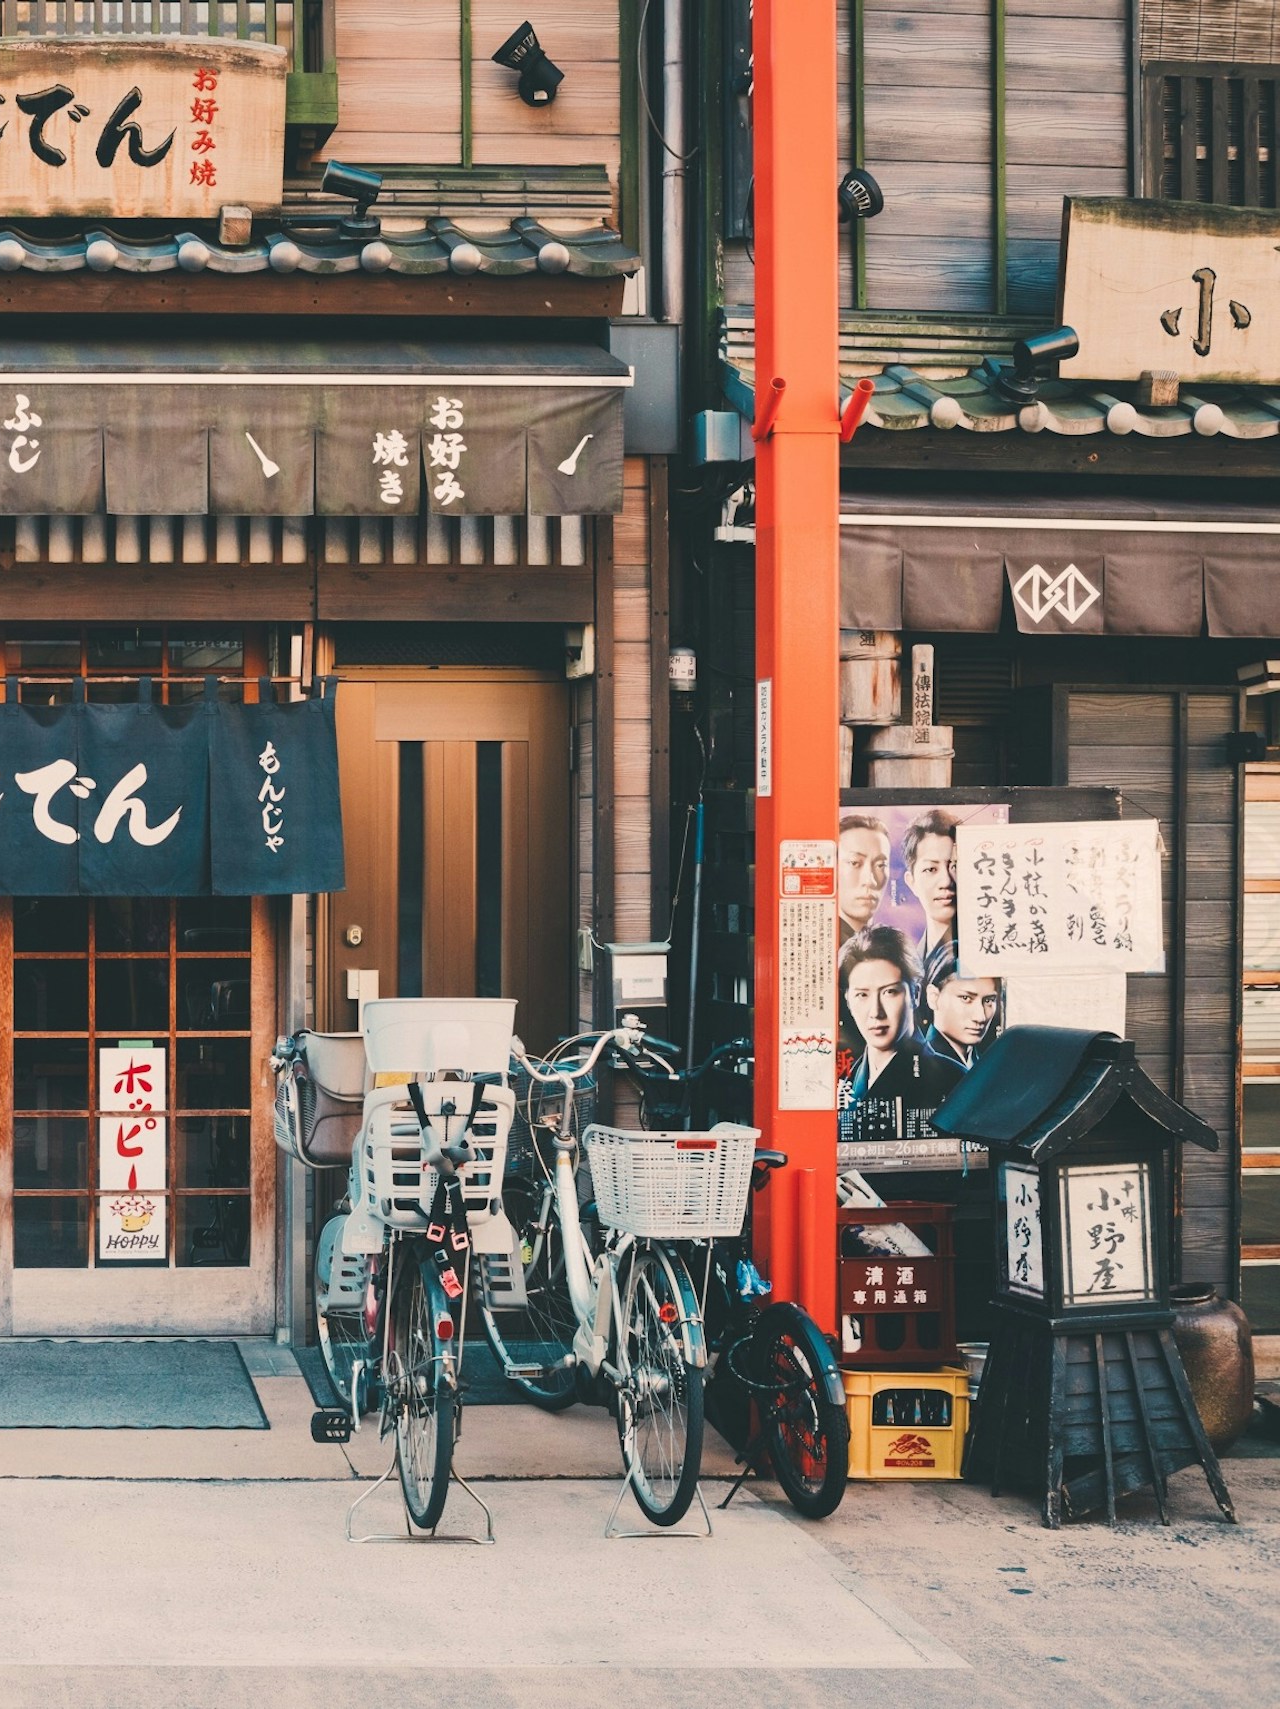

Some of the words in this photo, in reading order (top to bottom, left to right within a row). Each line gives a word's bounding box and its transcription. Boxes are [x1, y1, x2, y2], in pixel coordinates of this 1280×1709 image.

[188, 67, 219, 188] お好み焼
[1160, 267, 1252, 357] 小
[3, 393, 43, 474] ふじ
[373, 429, 410, 505] 焼き
[428, 396, 468, 507] お好み
[257, 740, 285, 853] もんじゃ
[865, 1266, 914, 1286] 清酒
[1013, 1184, 1033, 1283] 小野屋
[1086, 1187, 1125, 1293] 小野屋
